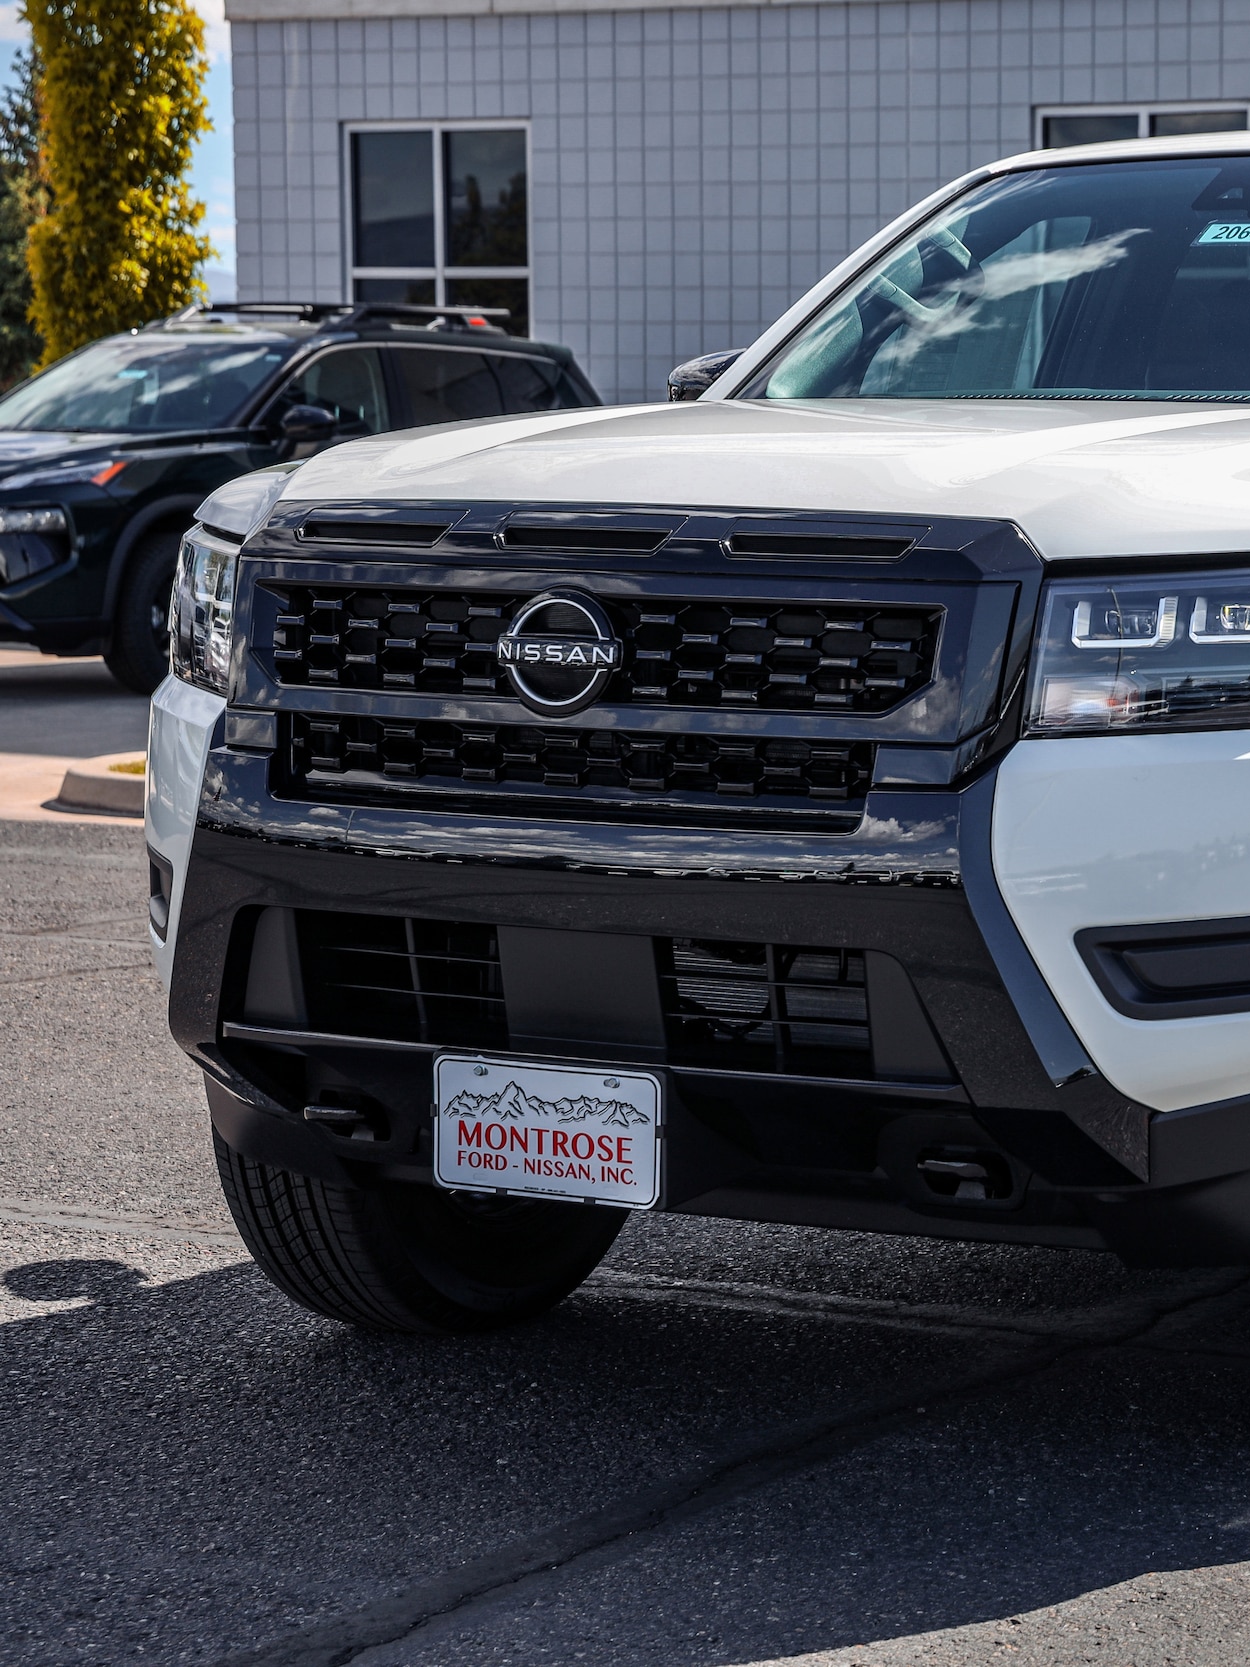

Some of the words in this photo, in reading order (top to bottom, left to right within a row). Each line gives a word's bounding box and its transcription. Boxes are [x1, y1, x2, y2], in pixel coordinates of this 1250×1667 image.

[498, 643, 614, 664] NISSAN
[458, 1120, 633, 1164] MONTROSE
[457, 1150, 508, 1171] FORD
[524, 1158, 595, 1184] NISSAN,
[601, 1166, 638, 1186] INC.
